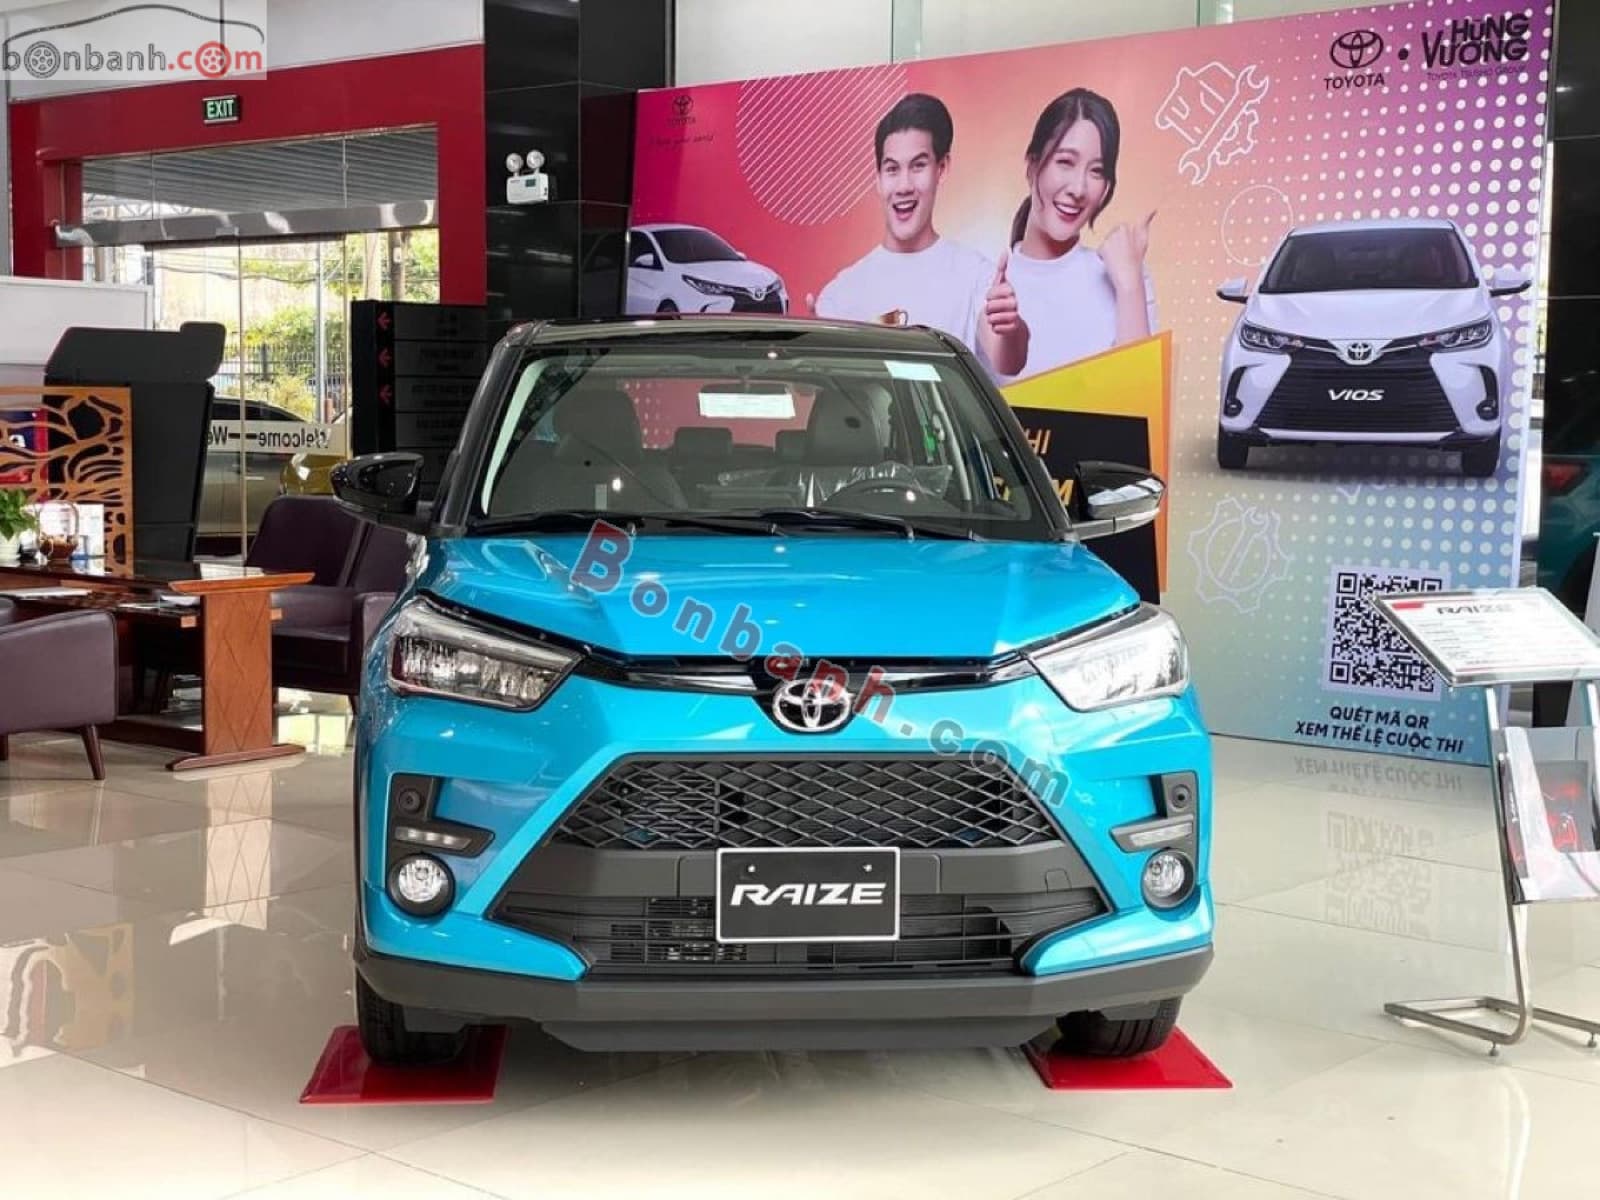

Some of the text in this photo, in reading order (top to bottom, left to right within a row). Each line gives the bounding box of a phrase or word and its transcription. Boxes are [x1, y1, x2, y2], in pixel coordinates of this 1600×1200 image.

[1324, 73, 1385, 90] TOYOTA
[206, 99, 236, 119] EXIT
[1328, 388, 1384, 401] VIOS
[1330, 706, 1430, 729] QUÉT MÃ QR
[1294, 721, 1464, 754] XEM THỂ LỆ CUỘC THI
[730, 883, 887, 906] RAIZE
